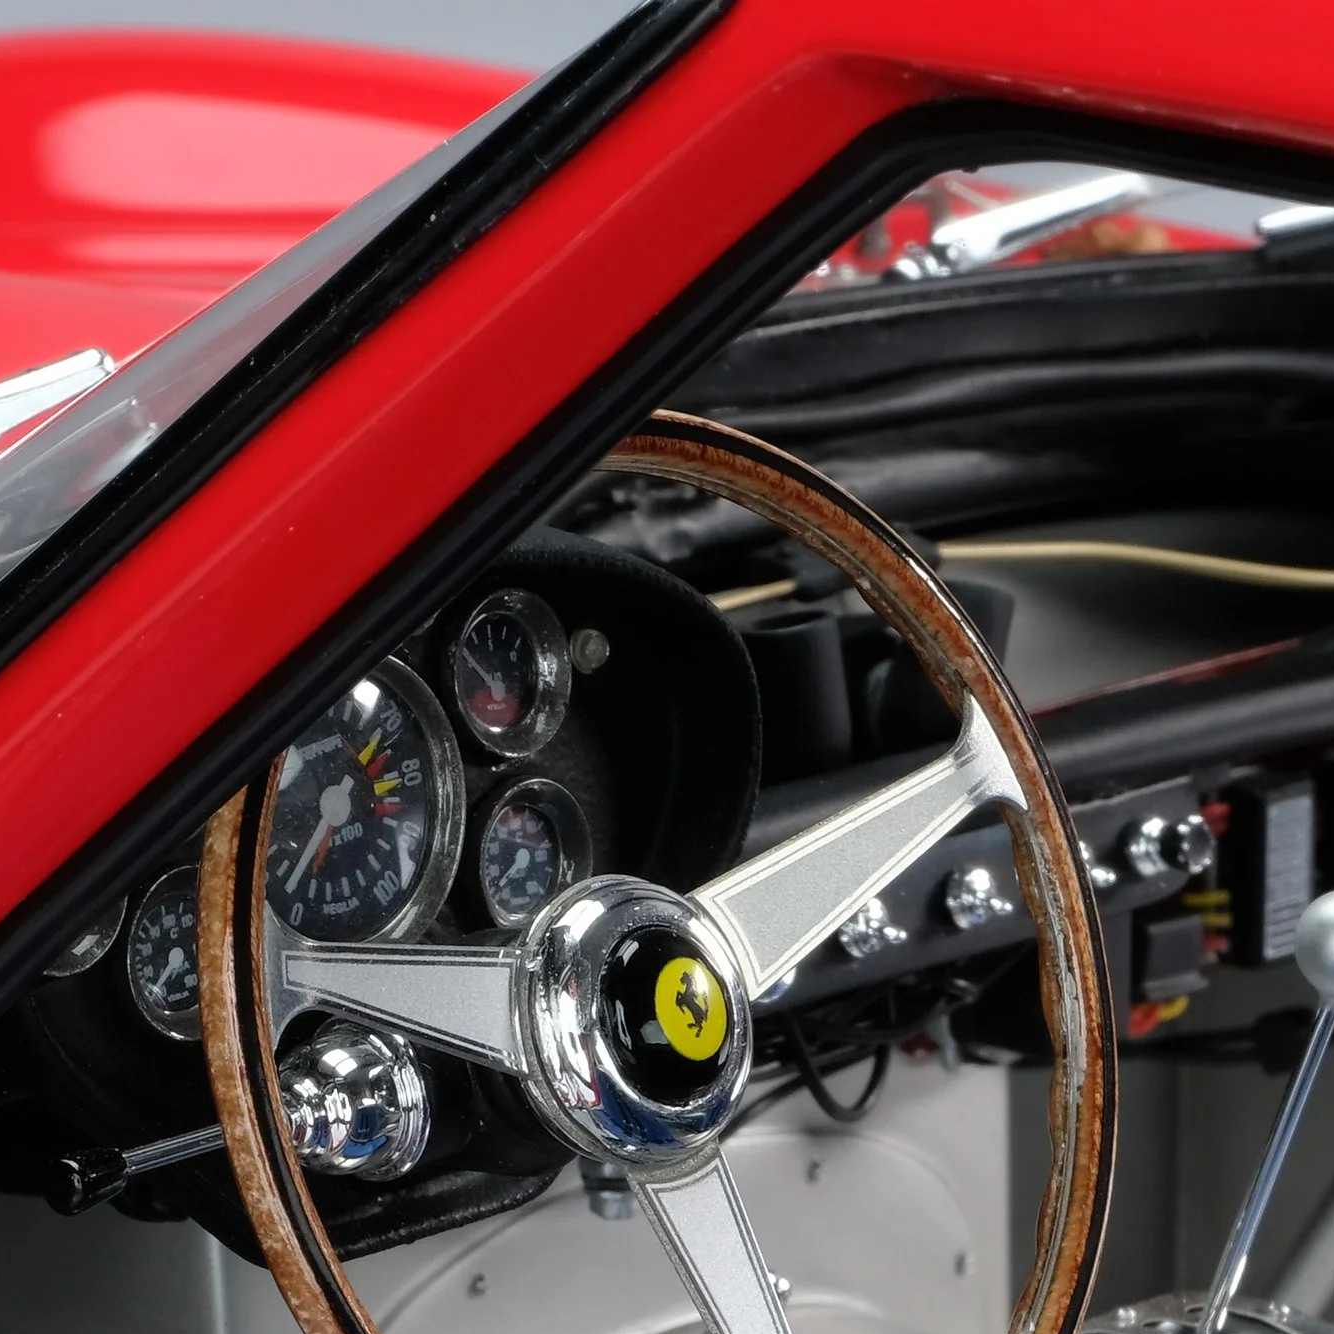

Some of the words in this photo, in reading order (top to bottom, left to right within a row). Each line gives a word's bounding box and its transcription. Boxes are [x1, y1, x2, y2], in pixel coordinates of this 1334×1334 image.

[379, 700, 403, 732] 70
[401, 758, 423, 787] 80
[373, 870, 400, 906] 100
[289, 902, 304, 926] 0
